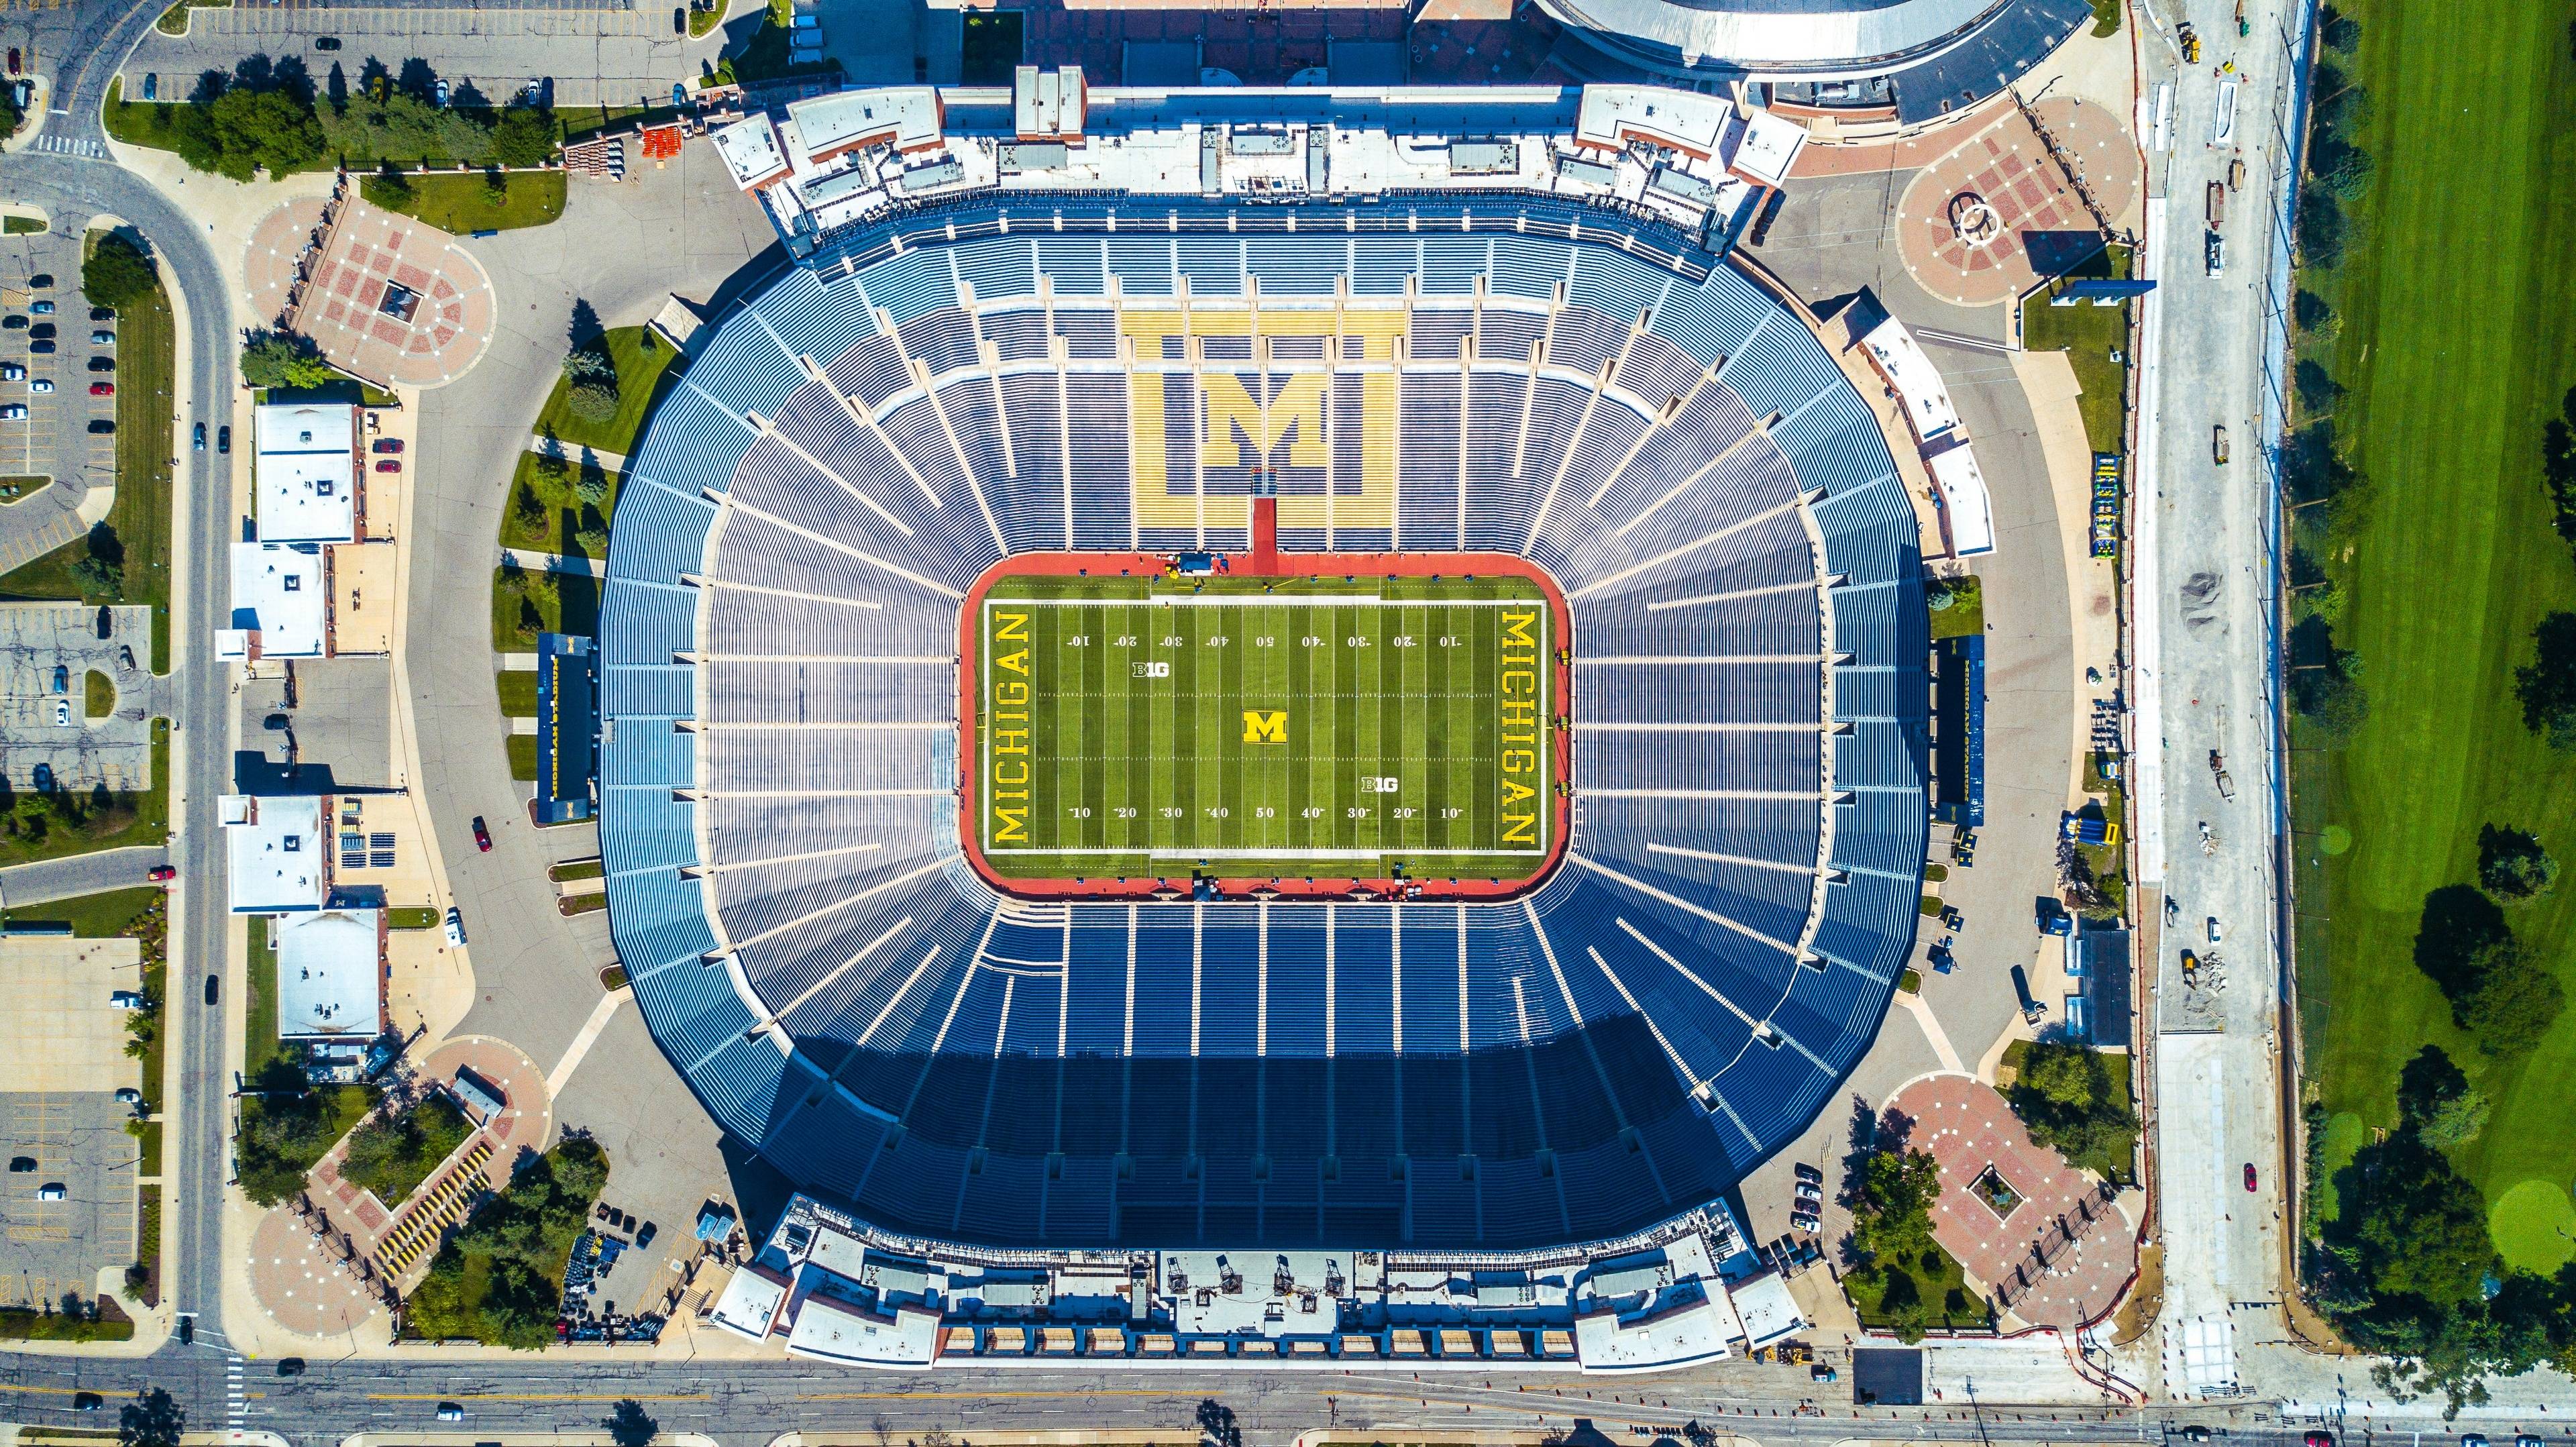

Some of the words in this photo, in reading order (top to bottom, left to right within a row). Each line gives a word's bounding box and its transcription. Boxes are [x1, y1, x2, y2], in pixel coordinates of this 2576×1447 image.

[1200, 373, 1328, 467] M
[1073, 636, 1090, 647] 10
[1118, 636, 1137, 647] 20
[1164, 636, 1183, 647] 30
[1210, 636, 1229, 647] 40
[1256, 636, 1274, 647] 50
[1302, 636, 1321, 647] 40
[1348, 636, 1366, 647] 30
[1394, 636, 1412, 647] 20
[1440, 636, 1458, 647] 10
[995, 610, 1029, 844] MICHIGAN
[1242, 711, 1288, 743] M
[1502, 611, 1536, 845] MICHIGAN
[1073, 808, 1091, 818] 10
[1118, 808, 1136, 818] 20
[1164, 808, 1183, 818] 30
[1210, 808, 1228, 818] 40
[1256, 808, 1274, 818] 50
[1301, 808, 1320, 818] 40
[1348, 808, 1366, 818] 30
[1393, 808, 1412, 818] 20
[1441, 808, 1458, 818] 10
